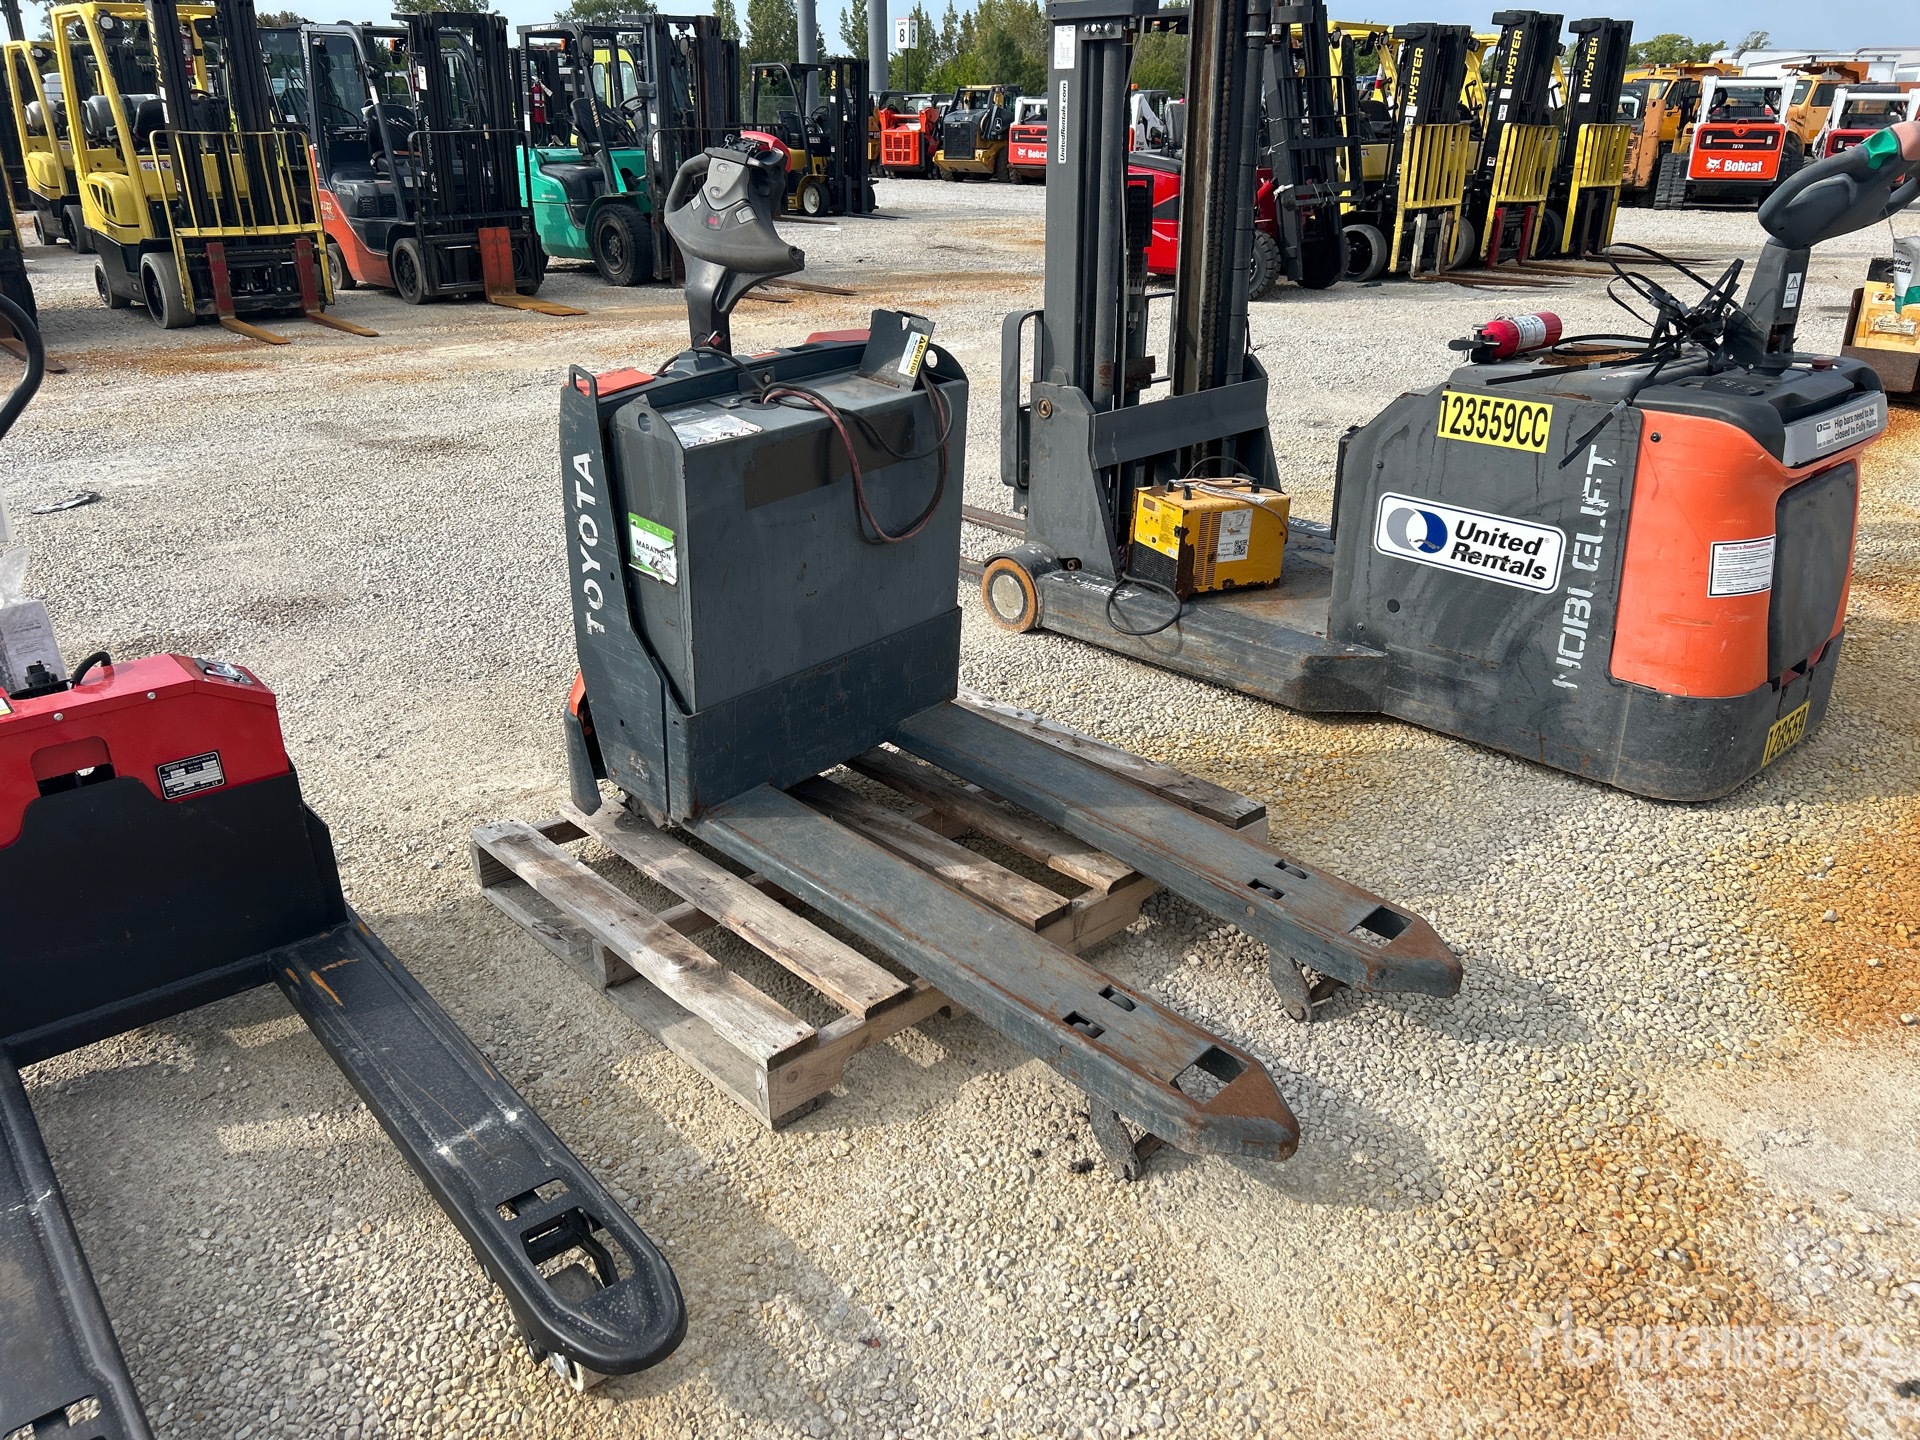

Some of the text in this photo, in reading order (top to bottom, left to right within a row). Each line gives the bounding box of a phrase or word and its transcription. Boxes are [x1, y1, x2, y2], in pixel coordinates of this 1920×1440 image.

[899, 28, 905, 42] 8
[911, 28, 916, 43] 8
[1504, 29, 1523, 85] HYSTER
[1406, 47, 1424, 106] HYSTER
[1723, 160, 1763, 172] Bobcat
[910, 344, 923, 375] CAUTION
[1440, 395, 1548, 447] 123559CC
[1834, 418, 1843, 428] Hip
[1844, 416, 1853, 425] bars
[1854, 411, 1864, 420] need
[1869, 407, 1874, 416] be
[1835, 428, 1850, 440] closed
[1856, 423, 1865, 432] Fully
[572, 453, 606, 635] TOYOTA
[1454, 519, 1545, 556] United
[1450, 541, 1547, 580] Rentals
[1764, 706, 1807, 763] 123559
